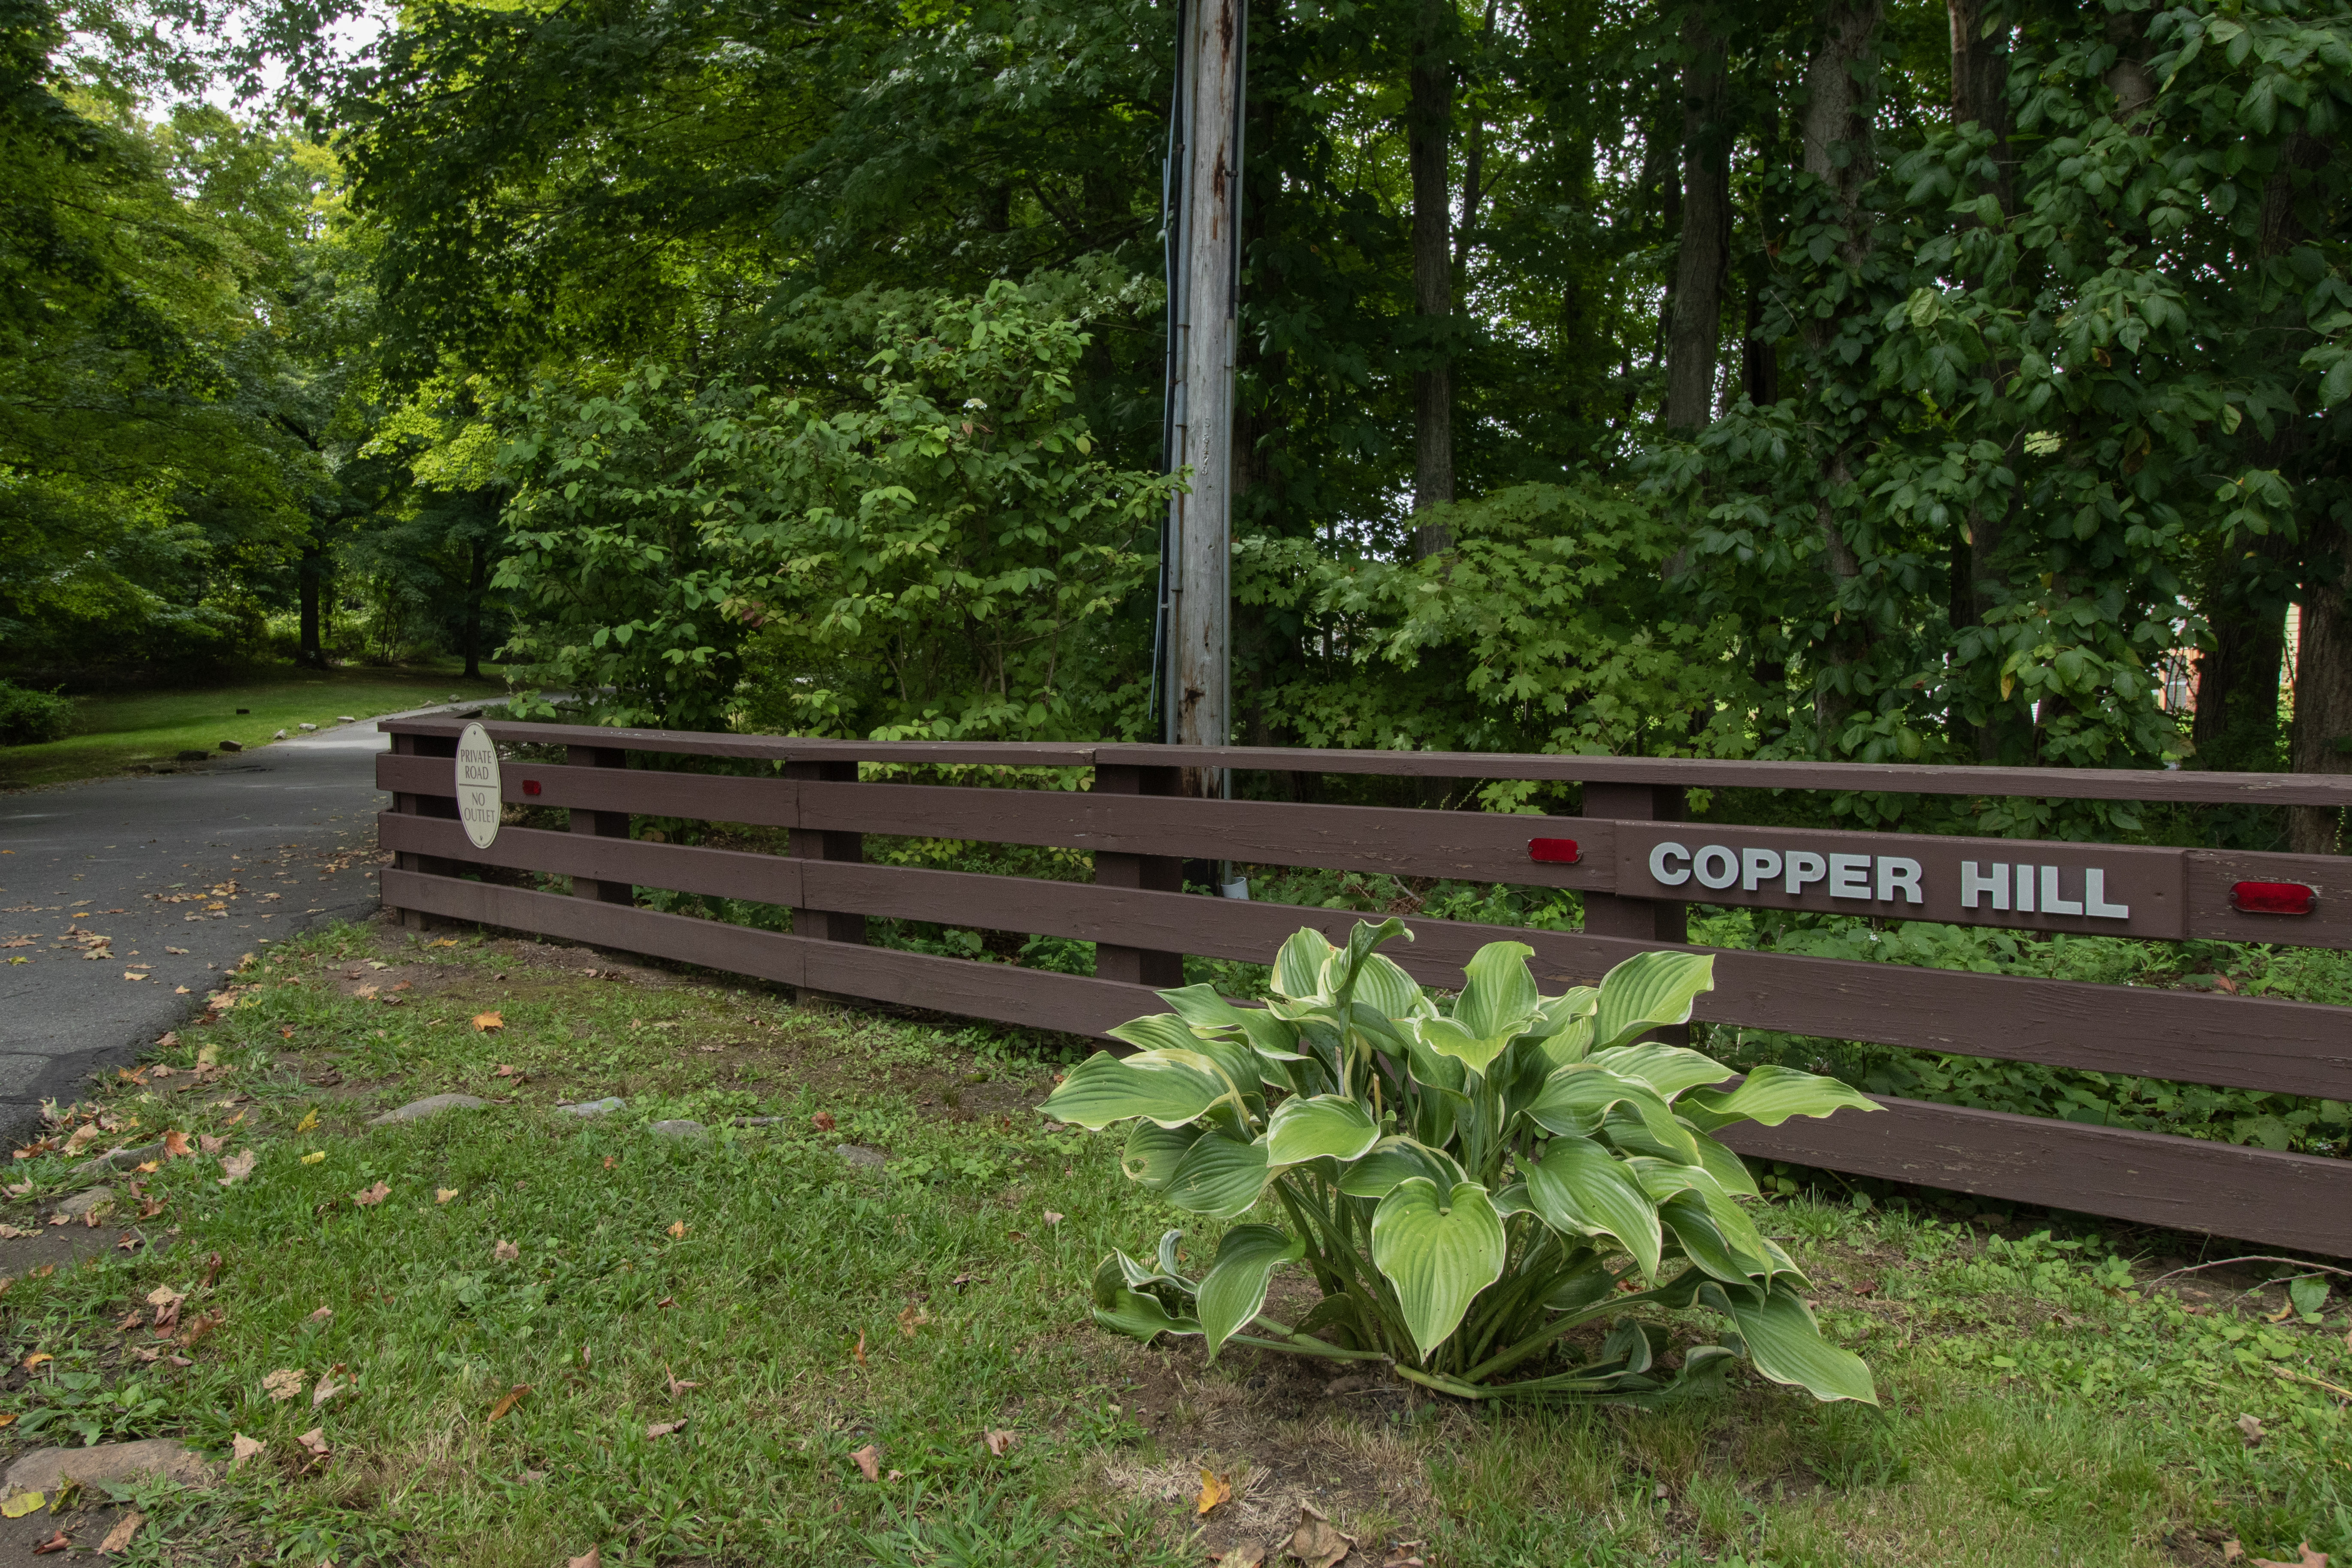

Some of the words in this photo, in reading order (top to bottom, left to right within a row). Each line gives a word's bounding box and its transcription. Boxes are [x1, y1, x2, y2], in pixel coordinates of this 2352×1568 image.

[461, 749, 492, 764] PRIVATE
[465, 766, 489, 779] ROAD
[472, 792, 485, 806] NO
[464, 807, 495, 823] OUTLET
[1649, 842, 1924, 904] COPPER
[1961, 861, 2129, 919] HILL
